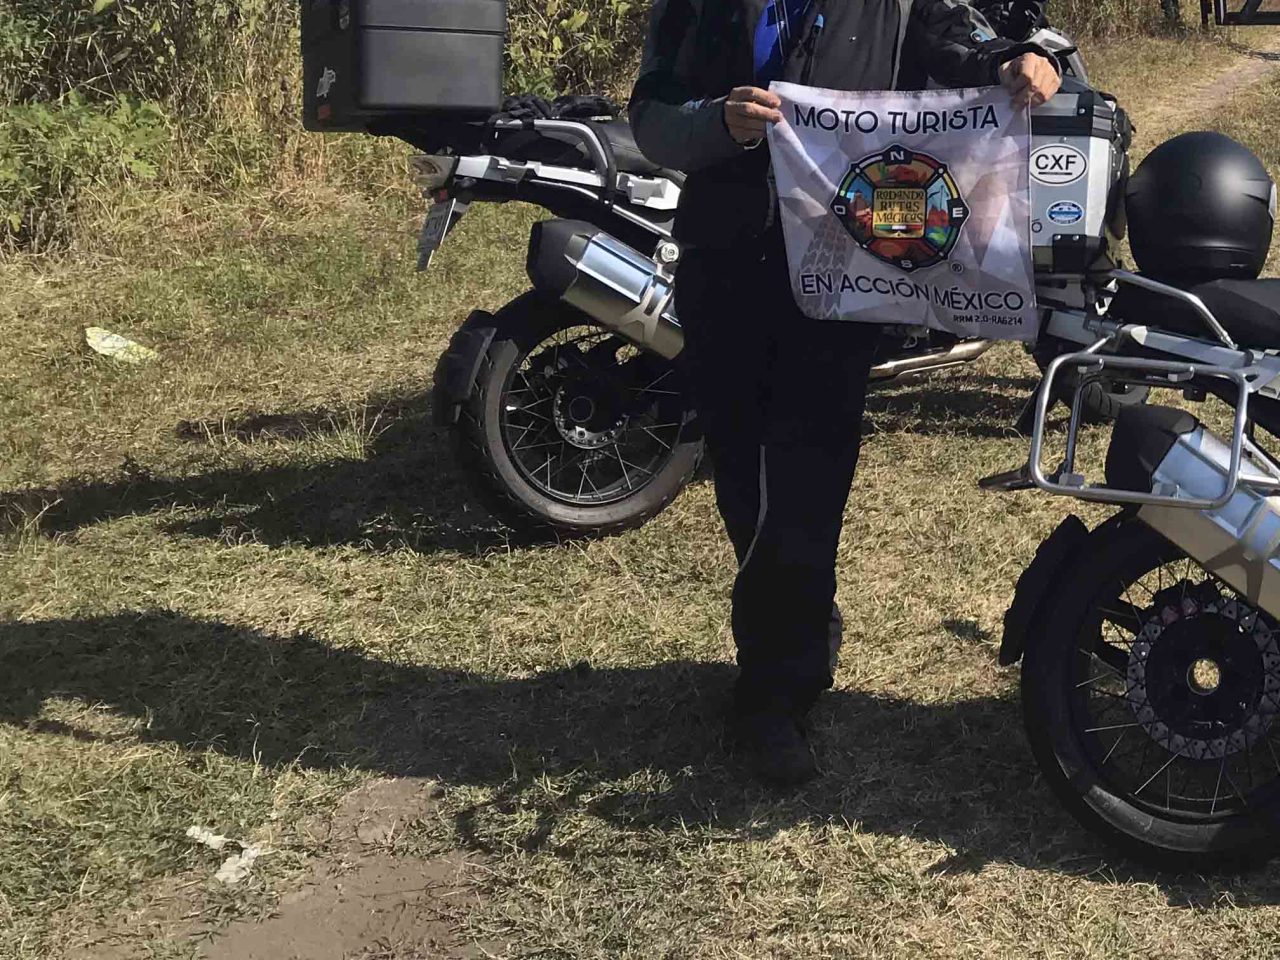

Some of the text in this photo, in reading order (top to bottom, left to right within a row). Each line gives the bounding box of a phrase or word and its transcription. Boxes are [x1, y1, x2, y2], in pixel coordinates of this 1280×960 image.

[794, 104, 999, 134] MOTO TURISTA
[890, 151, 904, 160] N
[1035, 154, 1077, 170] CXF
[952, 207, 963, 218] E
[800, 274, 1025, 311] EN ACCIÓN MÉXICO
